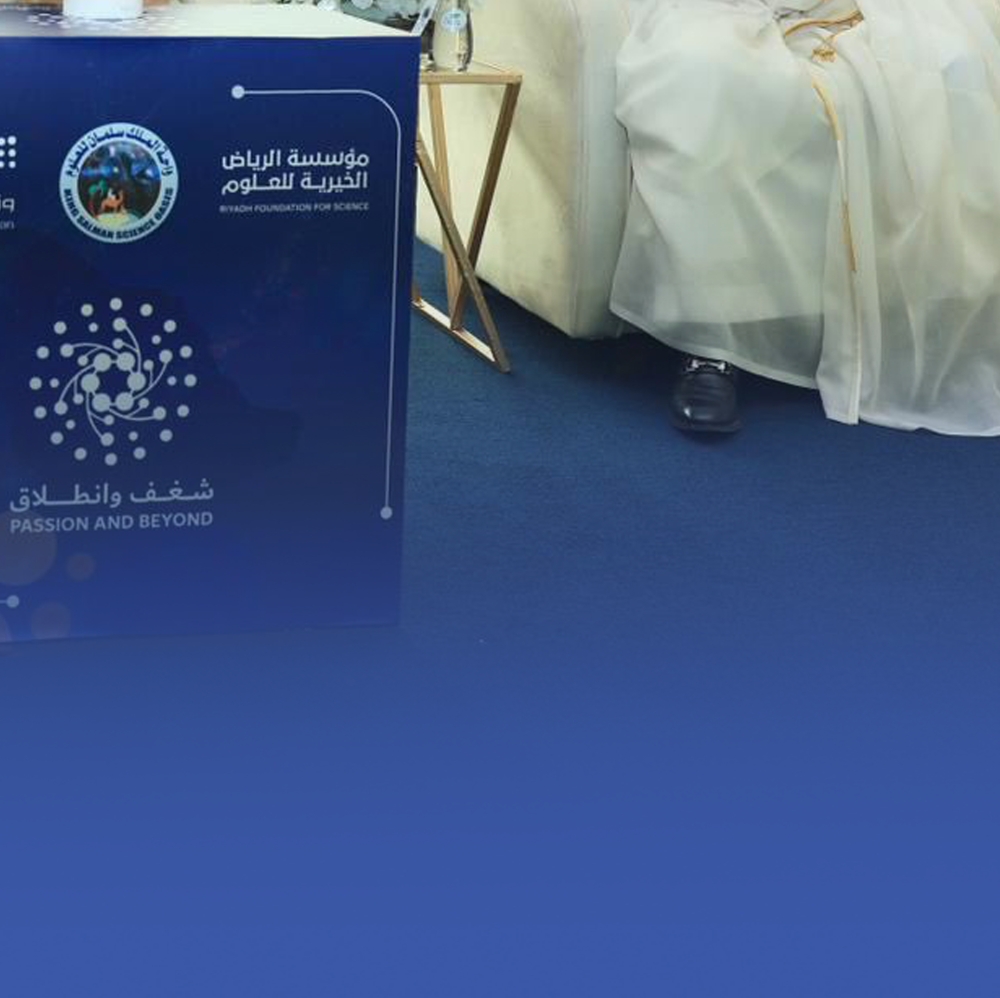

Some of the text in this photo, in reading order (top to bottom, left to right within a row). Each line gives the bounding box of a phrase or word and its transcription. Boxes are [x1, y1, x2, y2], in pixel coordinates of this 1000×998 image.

[221, 148, 370, 171] مؤسسة الرياض
[221, 171, 368, 196] الخيرية للعلوم
[63, 187, 174, 240] KING SALMAN SCIENCE OASIS
[219, 202, 369, 213] RIYADH FOUNDATION FOR SCIENCE
[9, 478, 215, 513] شغف وانطلاق
[10, 511, 213, 534] PASSION AND BEYOND
